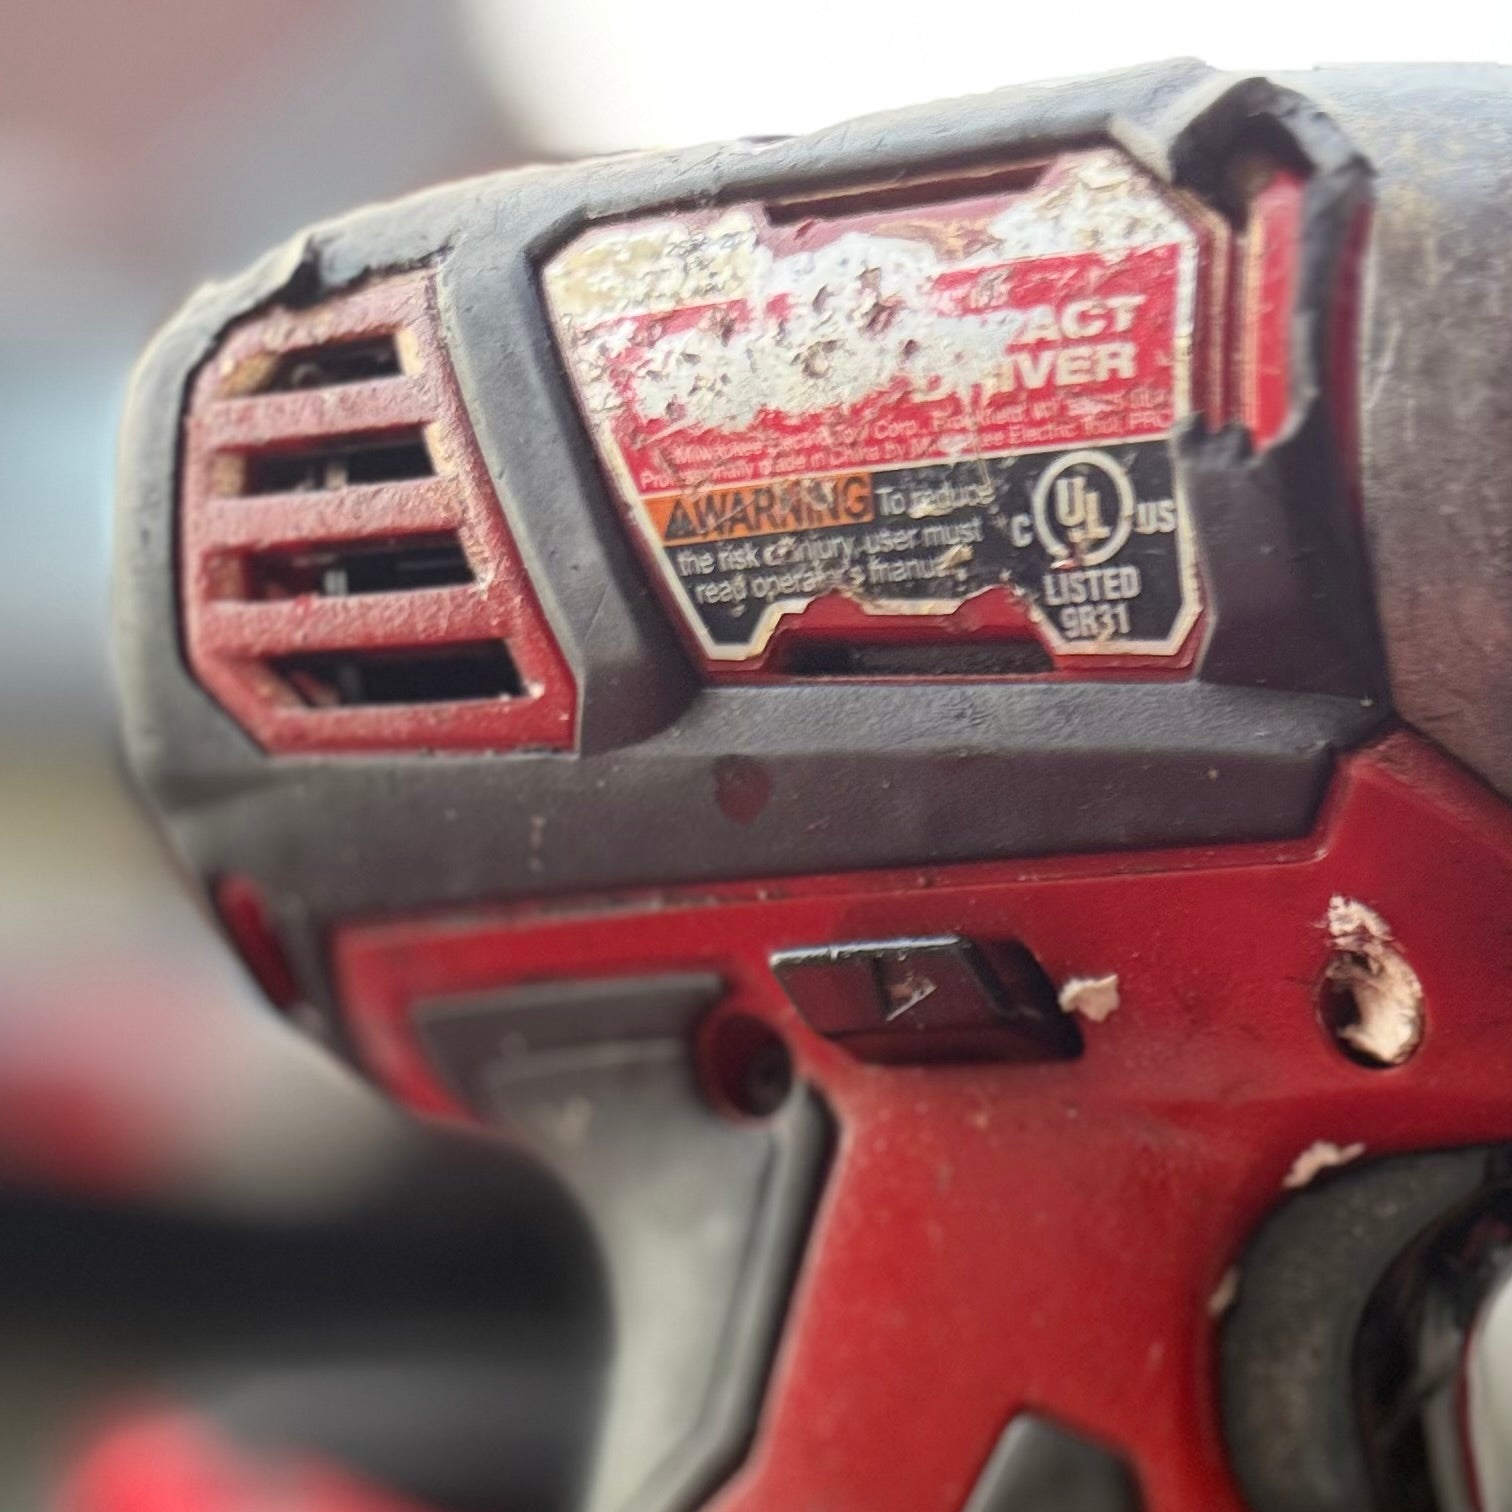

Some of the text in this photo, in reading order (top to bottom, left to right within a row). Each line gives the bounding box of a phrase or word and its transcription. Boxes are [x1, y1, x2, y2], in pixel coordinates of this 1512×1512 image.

[875, 486, 906, 516] To
[909, 480, 997, 518] reduce
[1054, 475, 1114, 543] UL
[676, 548, 716, 577] the
[716, 541, 761, 573] risk
[763, 535, 793, 566] o
[862, 527, 919, 555] user
[920, 515, 985, 549] must
[694, 546, 968, 605] read operats manu
[1042, 565, 1141, 607] LISTED
[1059, 602, 1131, 640] 9R31
